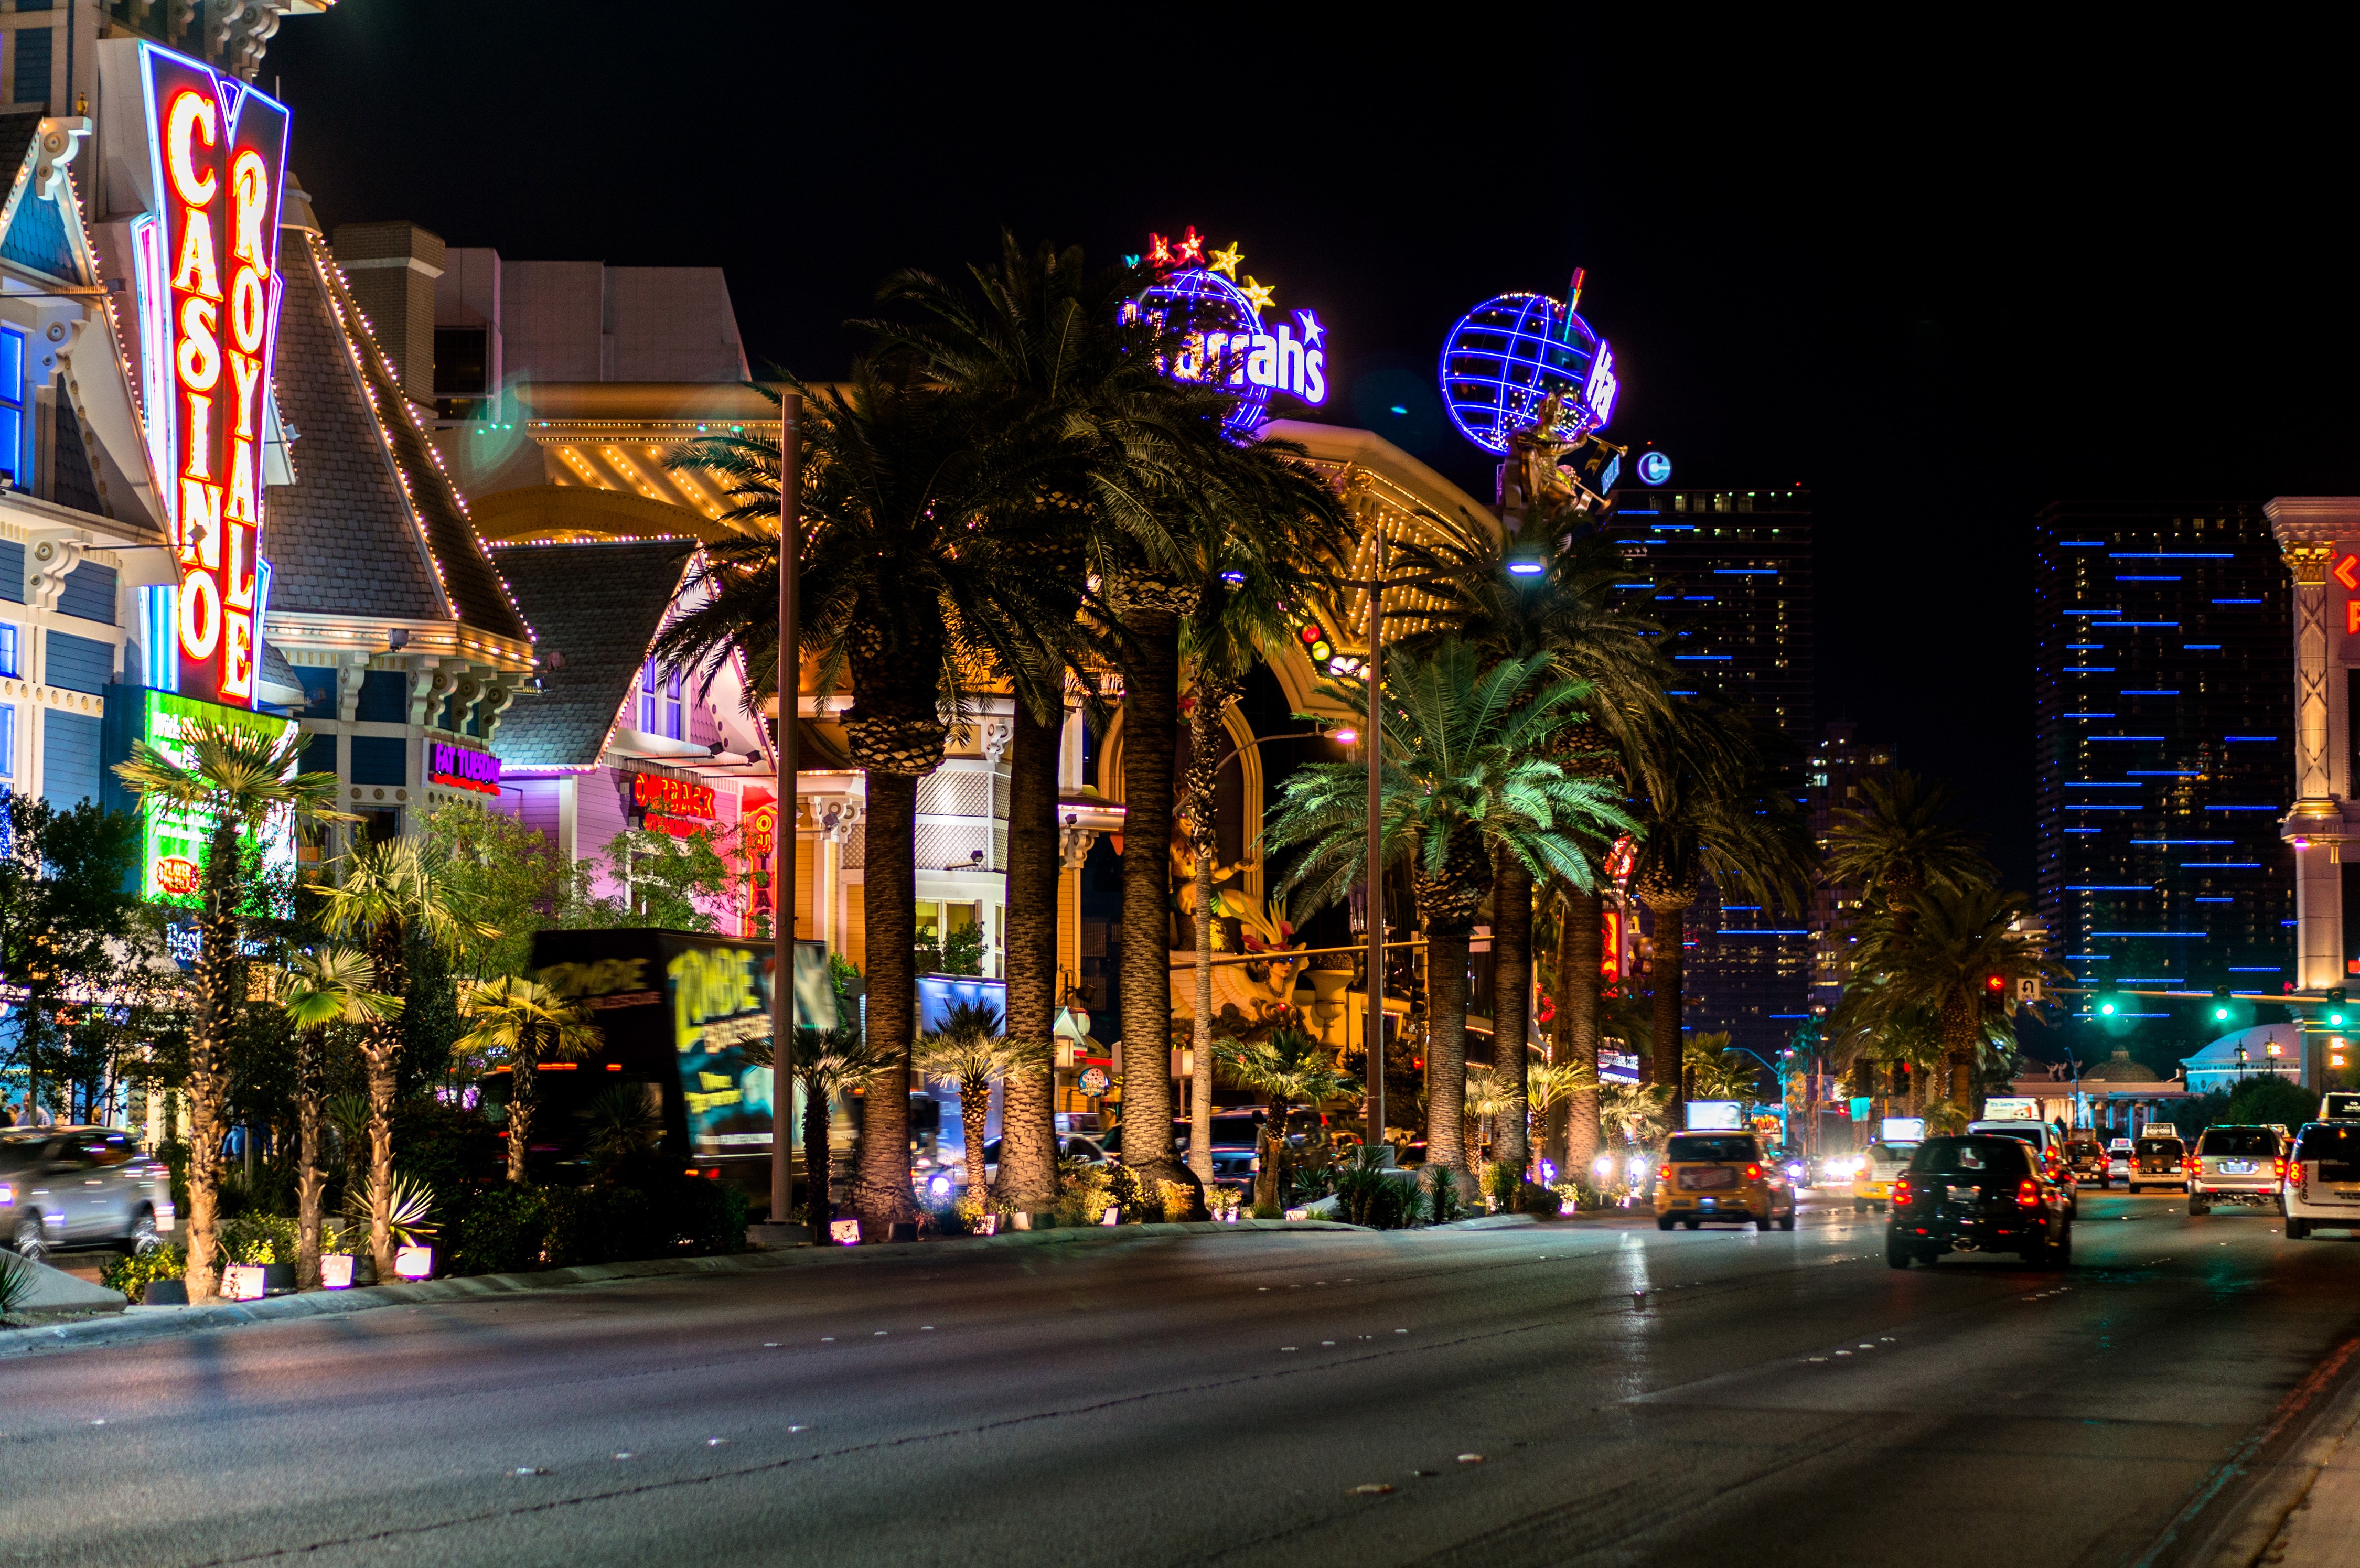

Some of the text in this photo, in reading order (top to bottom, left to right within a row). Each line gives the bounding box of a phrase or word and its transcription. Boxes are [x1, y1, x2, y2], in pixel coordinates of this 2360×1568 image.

[167, 90, 223, 660] CASINO
[223, 150, 270, 698] ROYALE
[436, 744, 501, 784] FAT TUESDAY
[635, 772, 715, 820] OUTBACK
[164, 861, 191, 877] PLAYER
